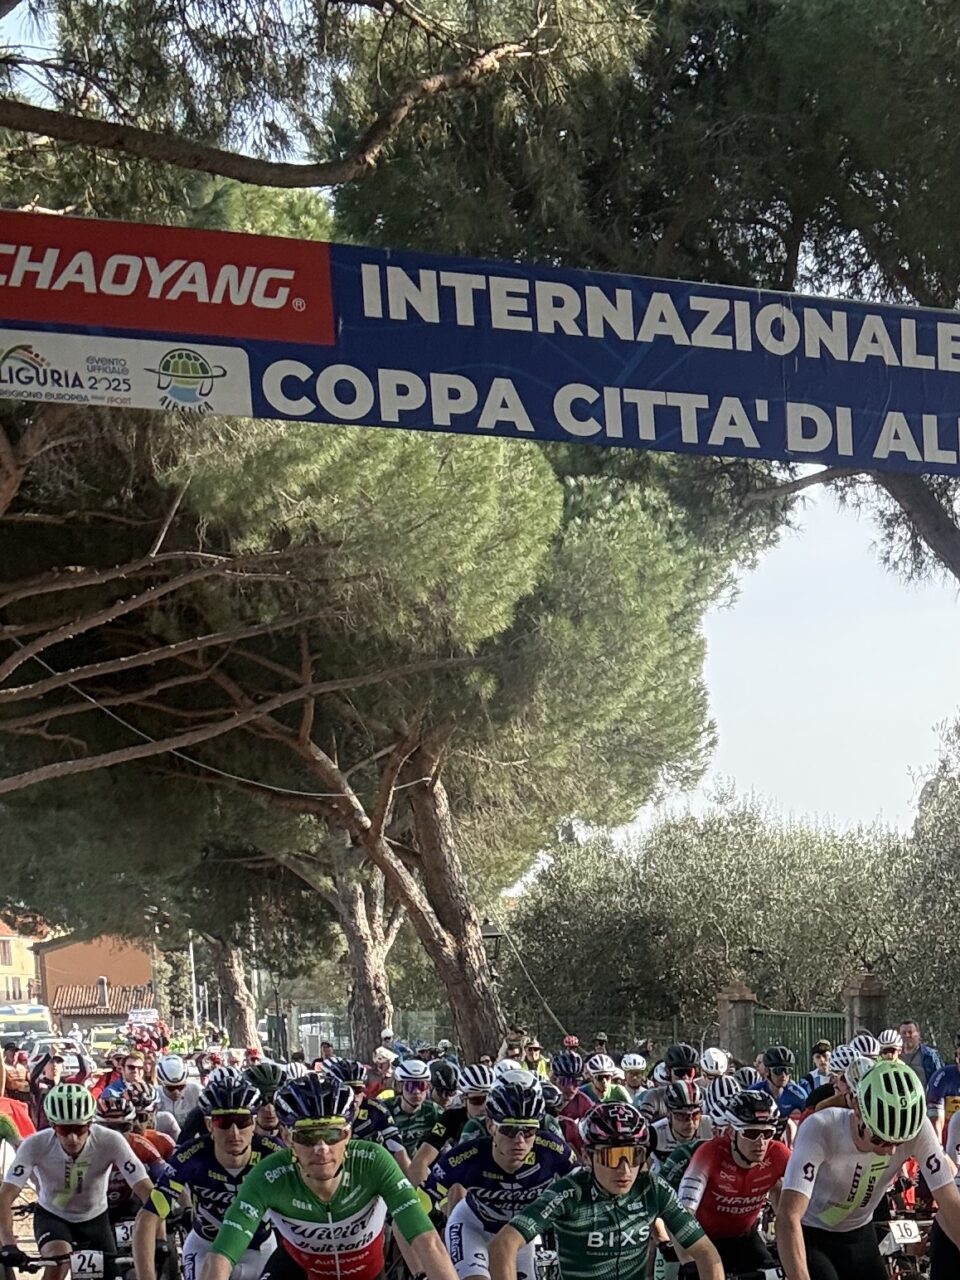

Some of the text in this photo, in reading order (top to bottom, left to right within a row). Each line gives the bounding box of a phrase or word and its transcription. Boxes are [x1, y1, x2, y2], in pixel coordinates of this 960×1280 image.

[88, 376, 131, 392] 2025
[261, 360, 534, 433] COPPA
[552, 382, 768, 449] CITTA'
[787, 401, 854, 456] DI
[847, 1162, 863, 1203] SCOTT
[282, 1204, 375, 1241] Wilier
[896, 1223, 913, 1238] 16
[587, 1226, 650, 1248] BIXS
[77, 1254, 97, 1273] 24
